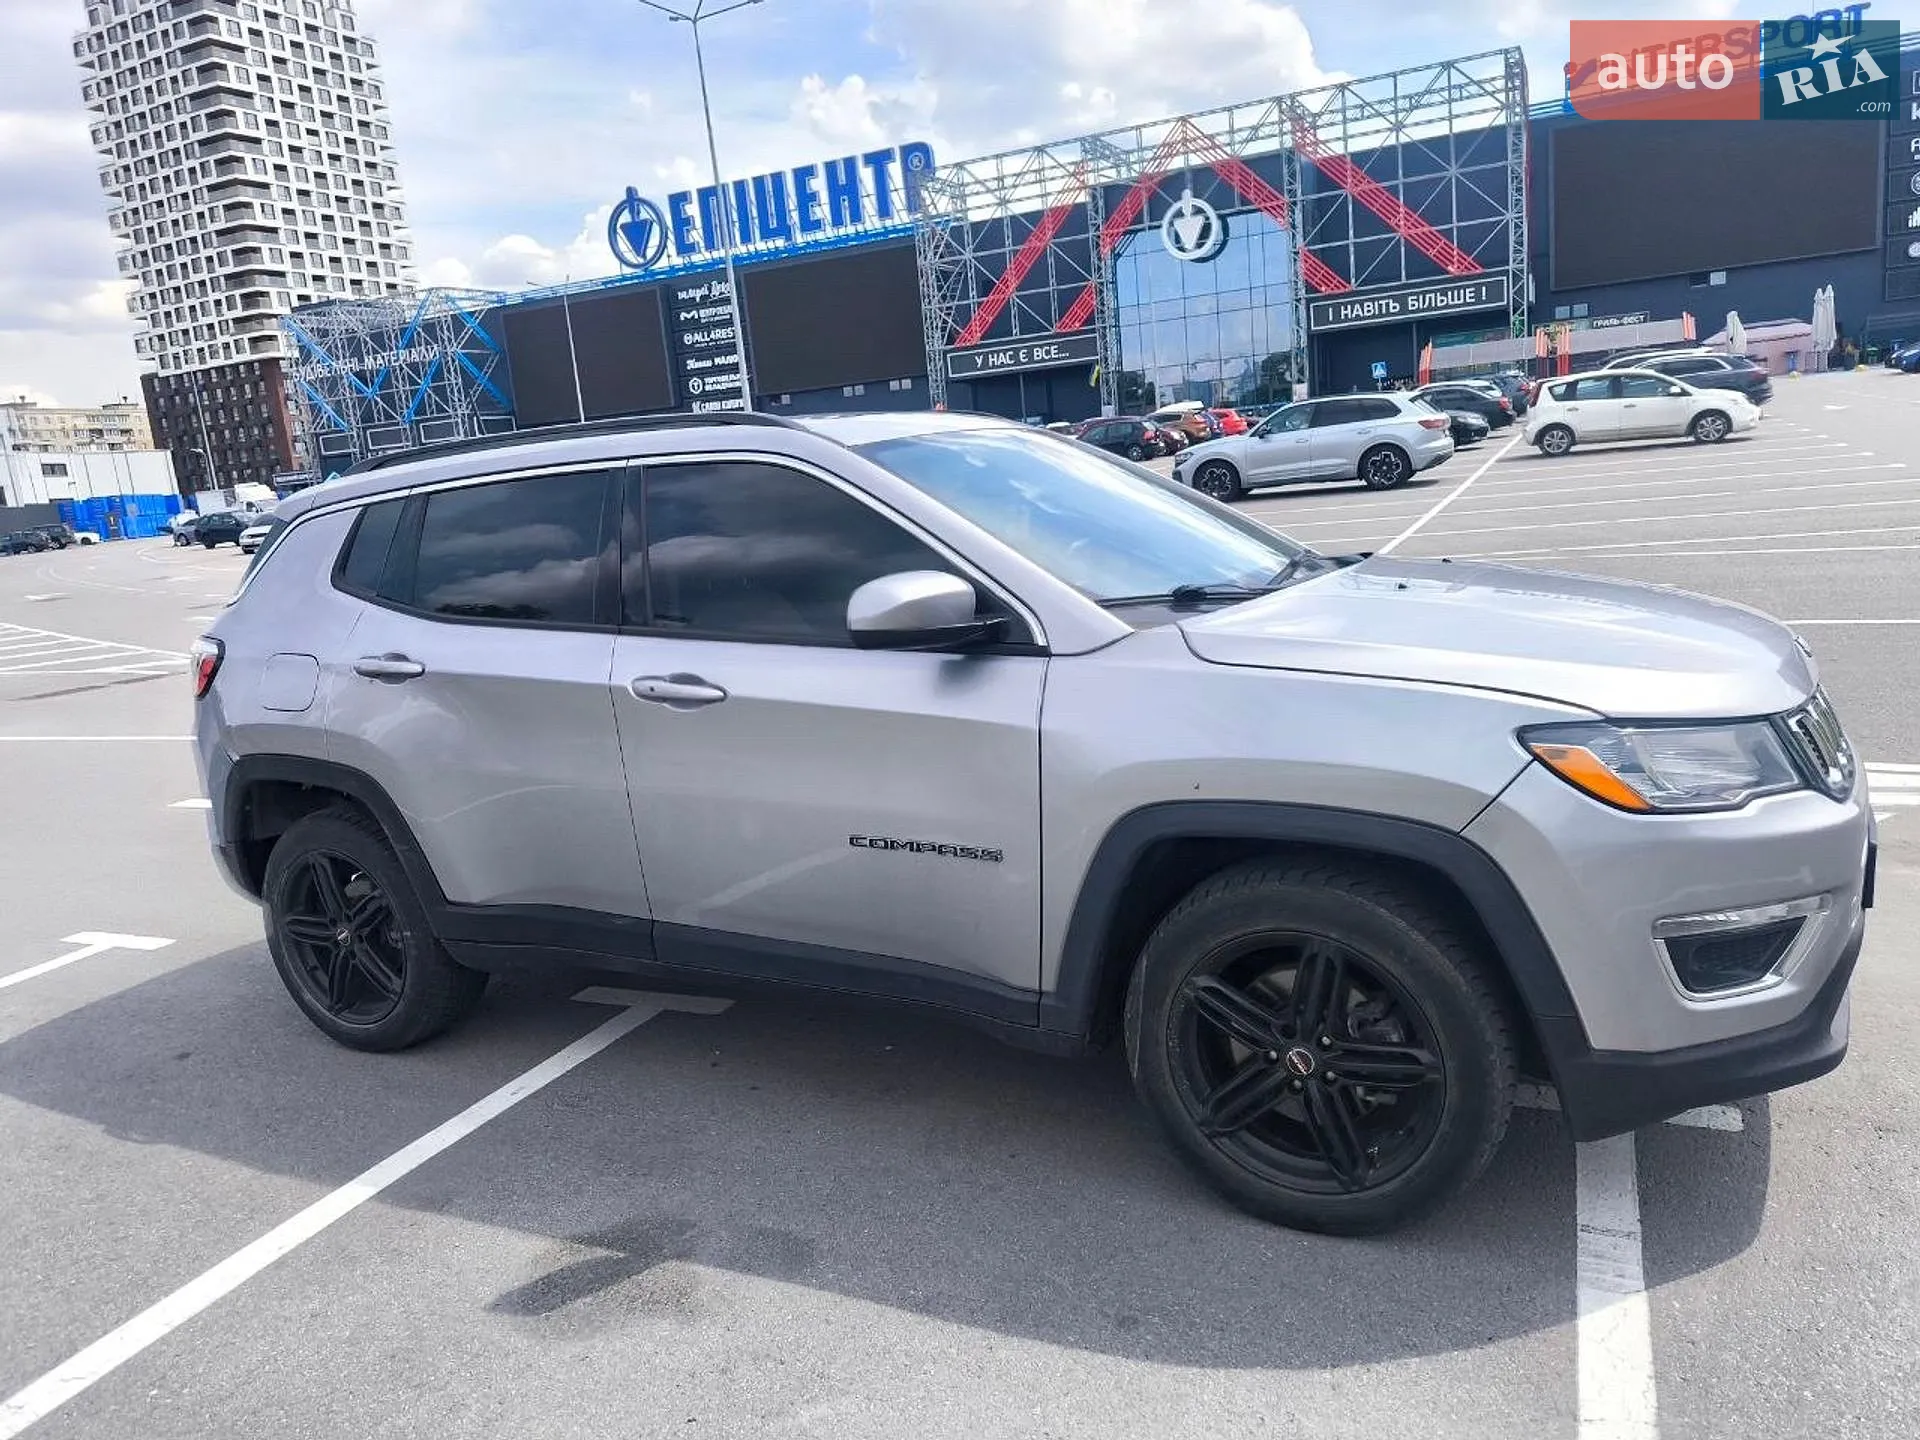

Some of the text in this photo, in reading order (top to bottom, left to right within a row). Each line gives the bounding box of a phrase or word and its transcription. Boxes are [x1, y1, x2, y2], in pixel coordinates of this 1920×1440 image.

[667, 141, 936, 258] ЕПІЦЕНТР
[1328, 307, 1333, 321] І
[1340, 299, 1400, 320] НАВІТЬ
[1408, 287, 1476, 311] БІЛЬШЕ
[974, 345, 1070, 368] У НАС Є ВСЕ...
[849, 835, 1004, 863] COMPASS
